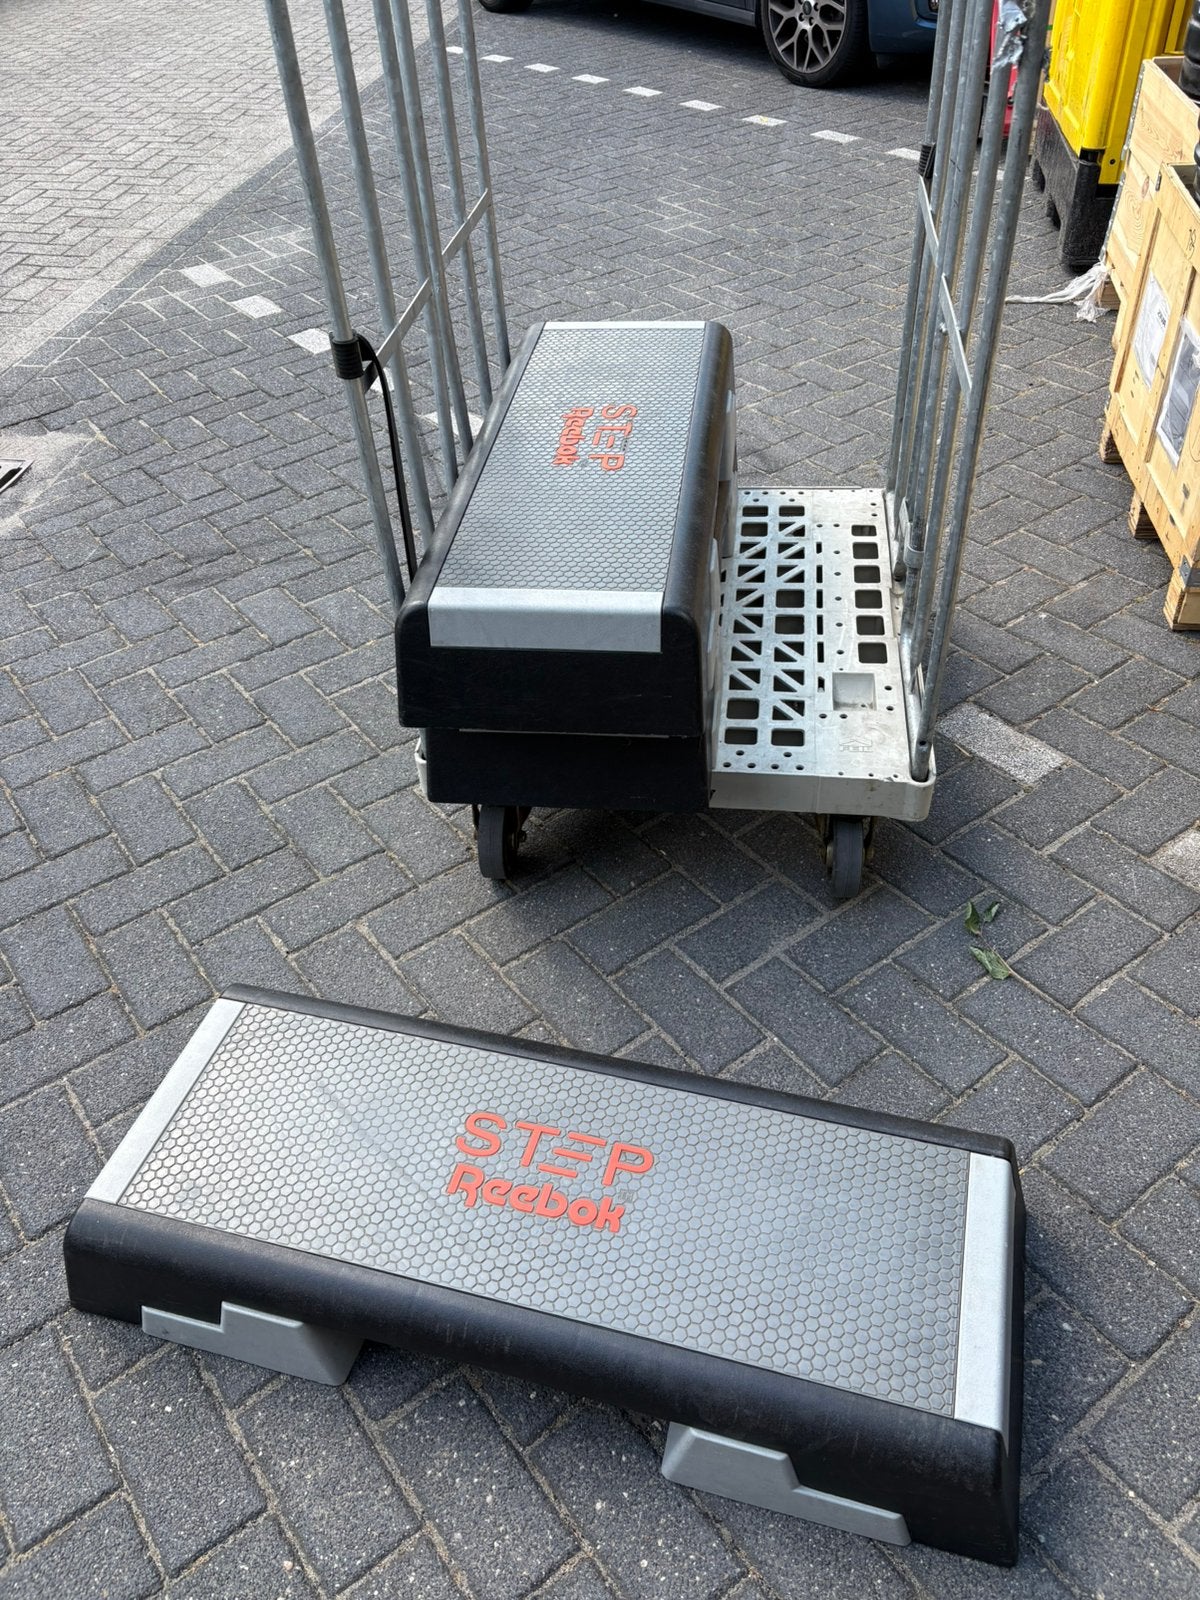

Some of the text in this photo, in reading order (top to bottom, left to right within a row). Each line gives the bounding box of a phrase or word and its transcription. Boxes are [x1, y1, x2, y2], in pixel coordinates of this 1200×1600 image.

[552, 407, 594, 465] Reebok
[588, 404, 638, 471] STEP
[456, 1111, 654, 1187] STEP
[447, 1163, 625, 1233] Reebok
